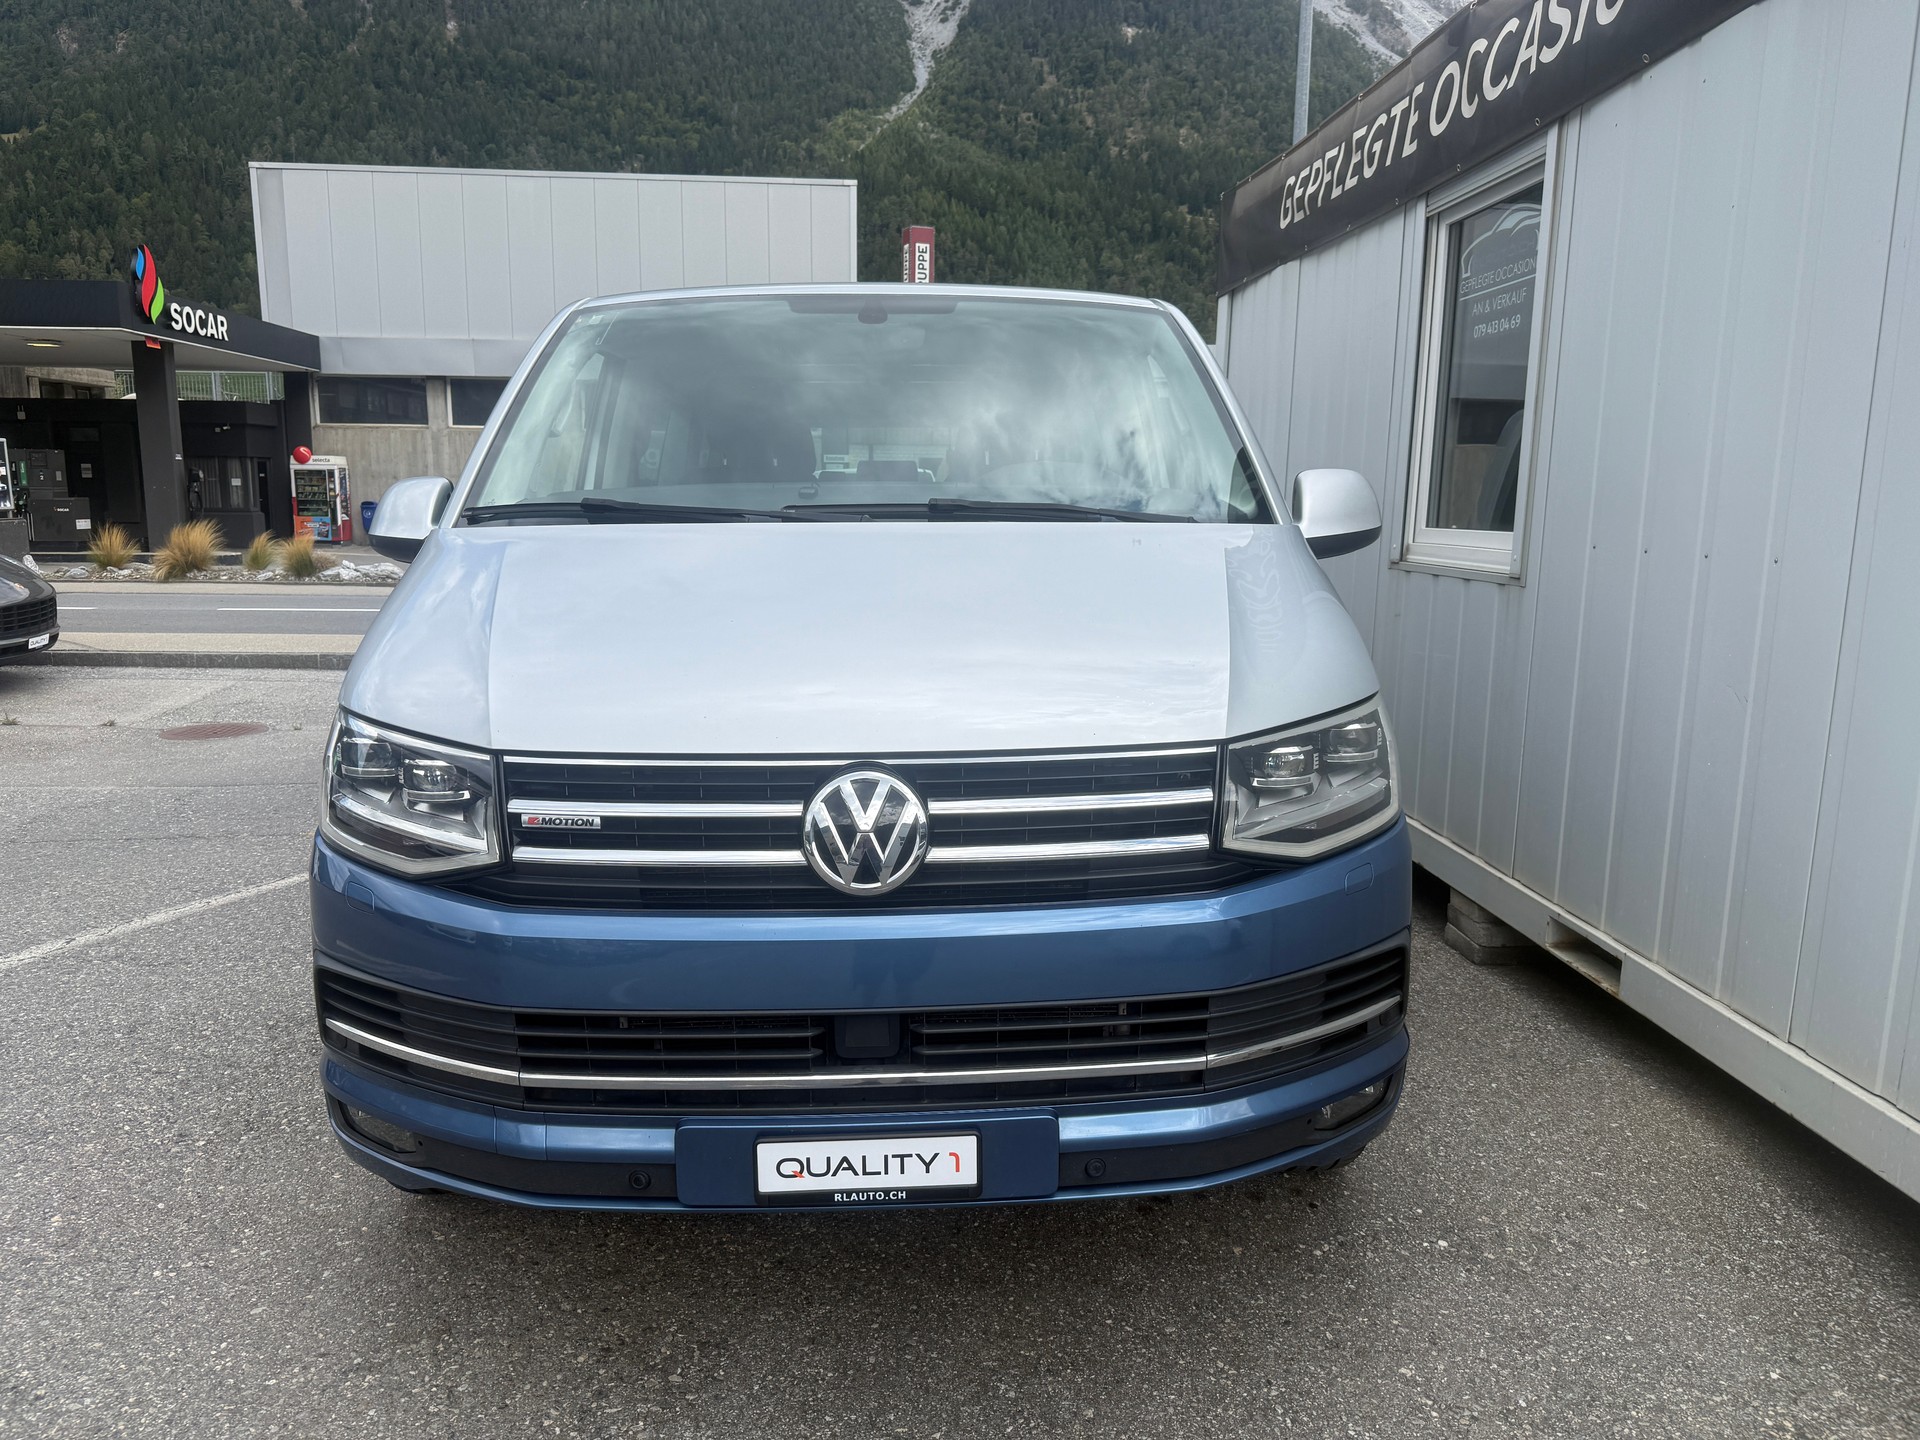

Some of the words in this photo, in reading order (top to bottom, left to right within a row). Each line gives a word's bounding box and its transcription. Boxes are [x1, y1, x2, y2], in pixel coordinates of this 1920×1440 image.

[1279, 82, 1425, 229] GEPFLEGTE
[1429, 0, 1624, 137] OCCASI
[917, 245, 928, 283] UPPE
[1459, 270, 1495, 294] GEPFLEGTE
[1471, 301, 1484, 316] AN
[1484, 299, 1490, 313] &
[1492, 287, 1527, 310] VERKAUF
[170, 302, 229, 341] SOCAR
[1473, 323, 1487, 338] 079
[1487, 319, 1499, 334] 413
[1499, 317, 1510, 332] 04
[1510, 314, 1521, 329] 69
[776, 1152, 940, 1179] QUALITY
[949, 1151, 961, 1173] 1
[834, 1190, 907, 1202] RLAUTO.CH
